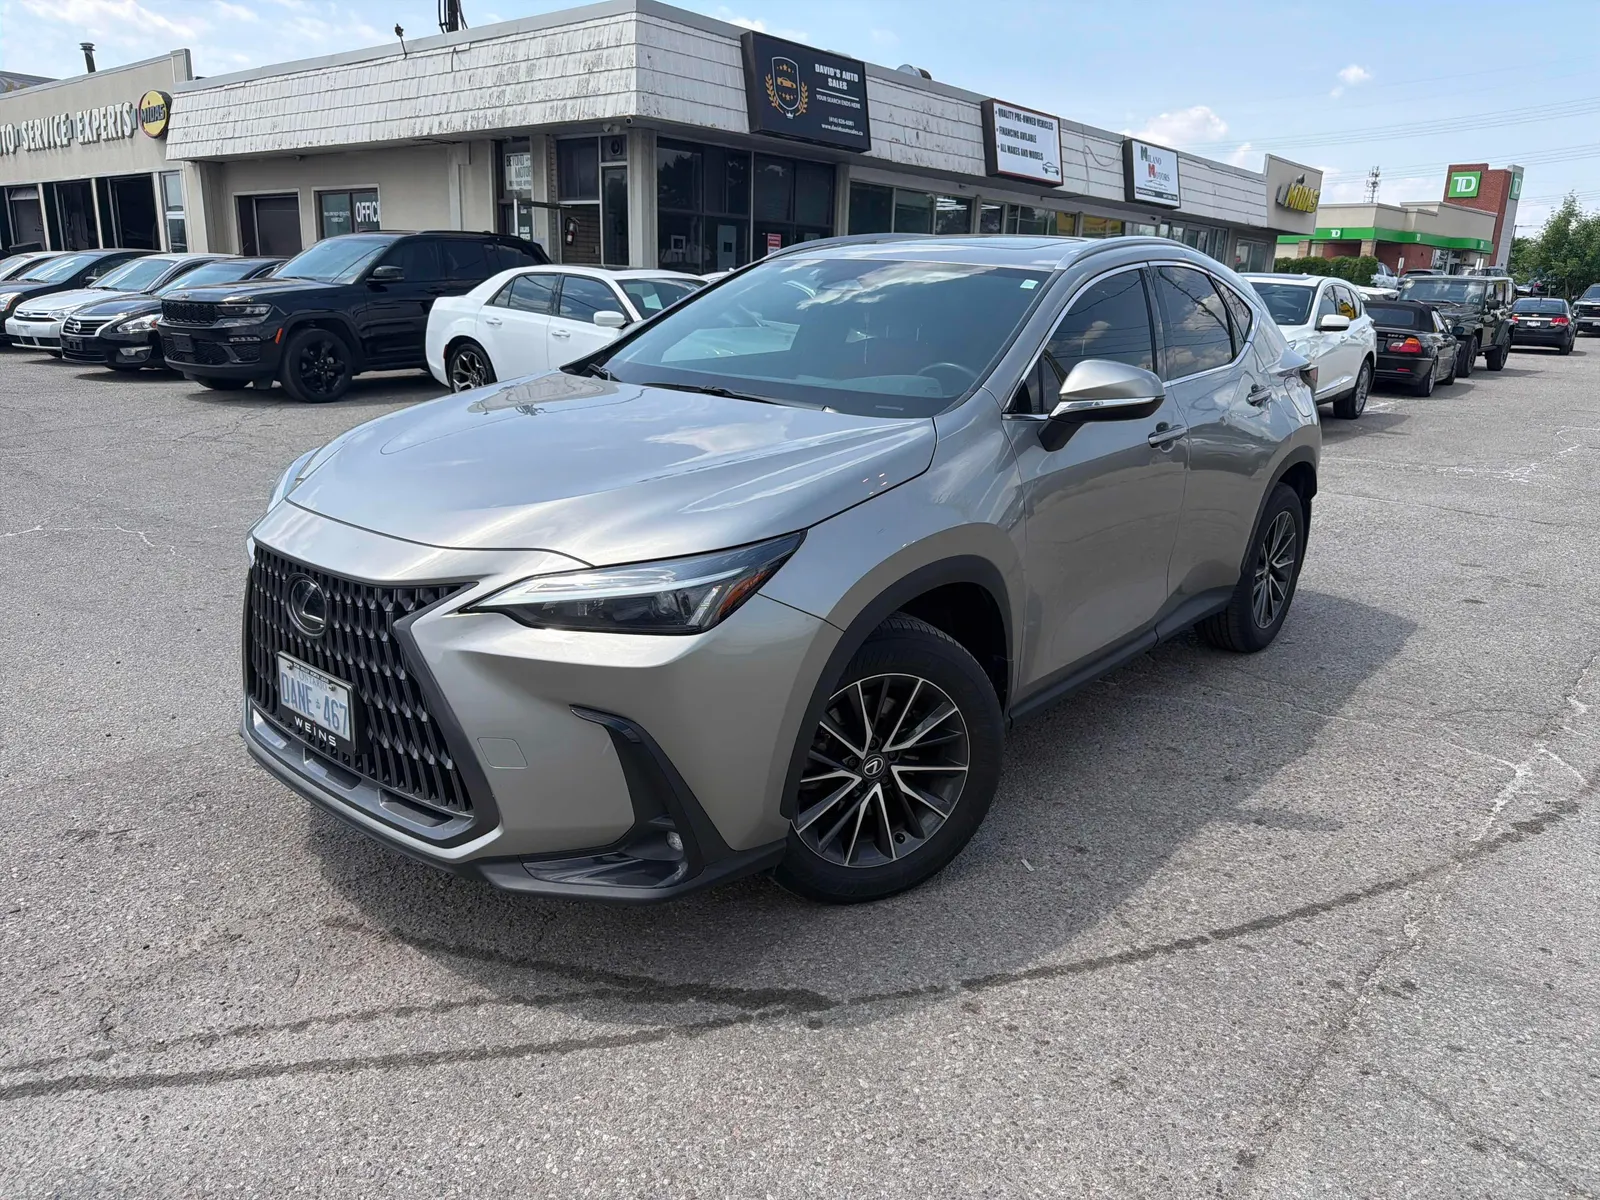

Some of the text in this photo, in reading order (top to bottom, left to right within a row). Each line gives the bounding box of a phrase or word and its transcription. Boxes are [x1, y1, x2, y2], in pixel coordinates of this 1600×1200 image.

[815, 64, 859, 83] DAVID'S AUTO
[828, 78, 848, 90] SALES
[141, 104, 165, 124] MIDAS
[998, 107, 1054, 131] QUALITY PRE-OWNED VEHICLES
[21, 112, 70, 151] SERVICE
[76, 101, 136, 144] EXPERTS
[999, 126, 1019, 139] FINANCING
[1007, 145, 1020, 156] MAKES
[1020, 148, 1028, 158] AND
[1029, 150, 1044, 161] MODELS
[1140, 145, 1162, 165] MILANO
[1148, 163, 1171, 182] MOTORS
[1453, 176, 1477, 193] TD
[1283, 182, 1320, 213] MIDAS
[1330, 229, 1341, 238] TD
[323, 695, 348, 736] 467
